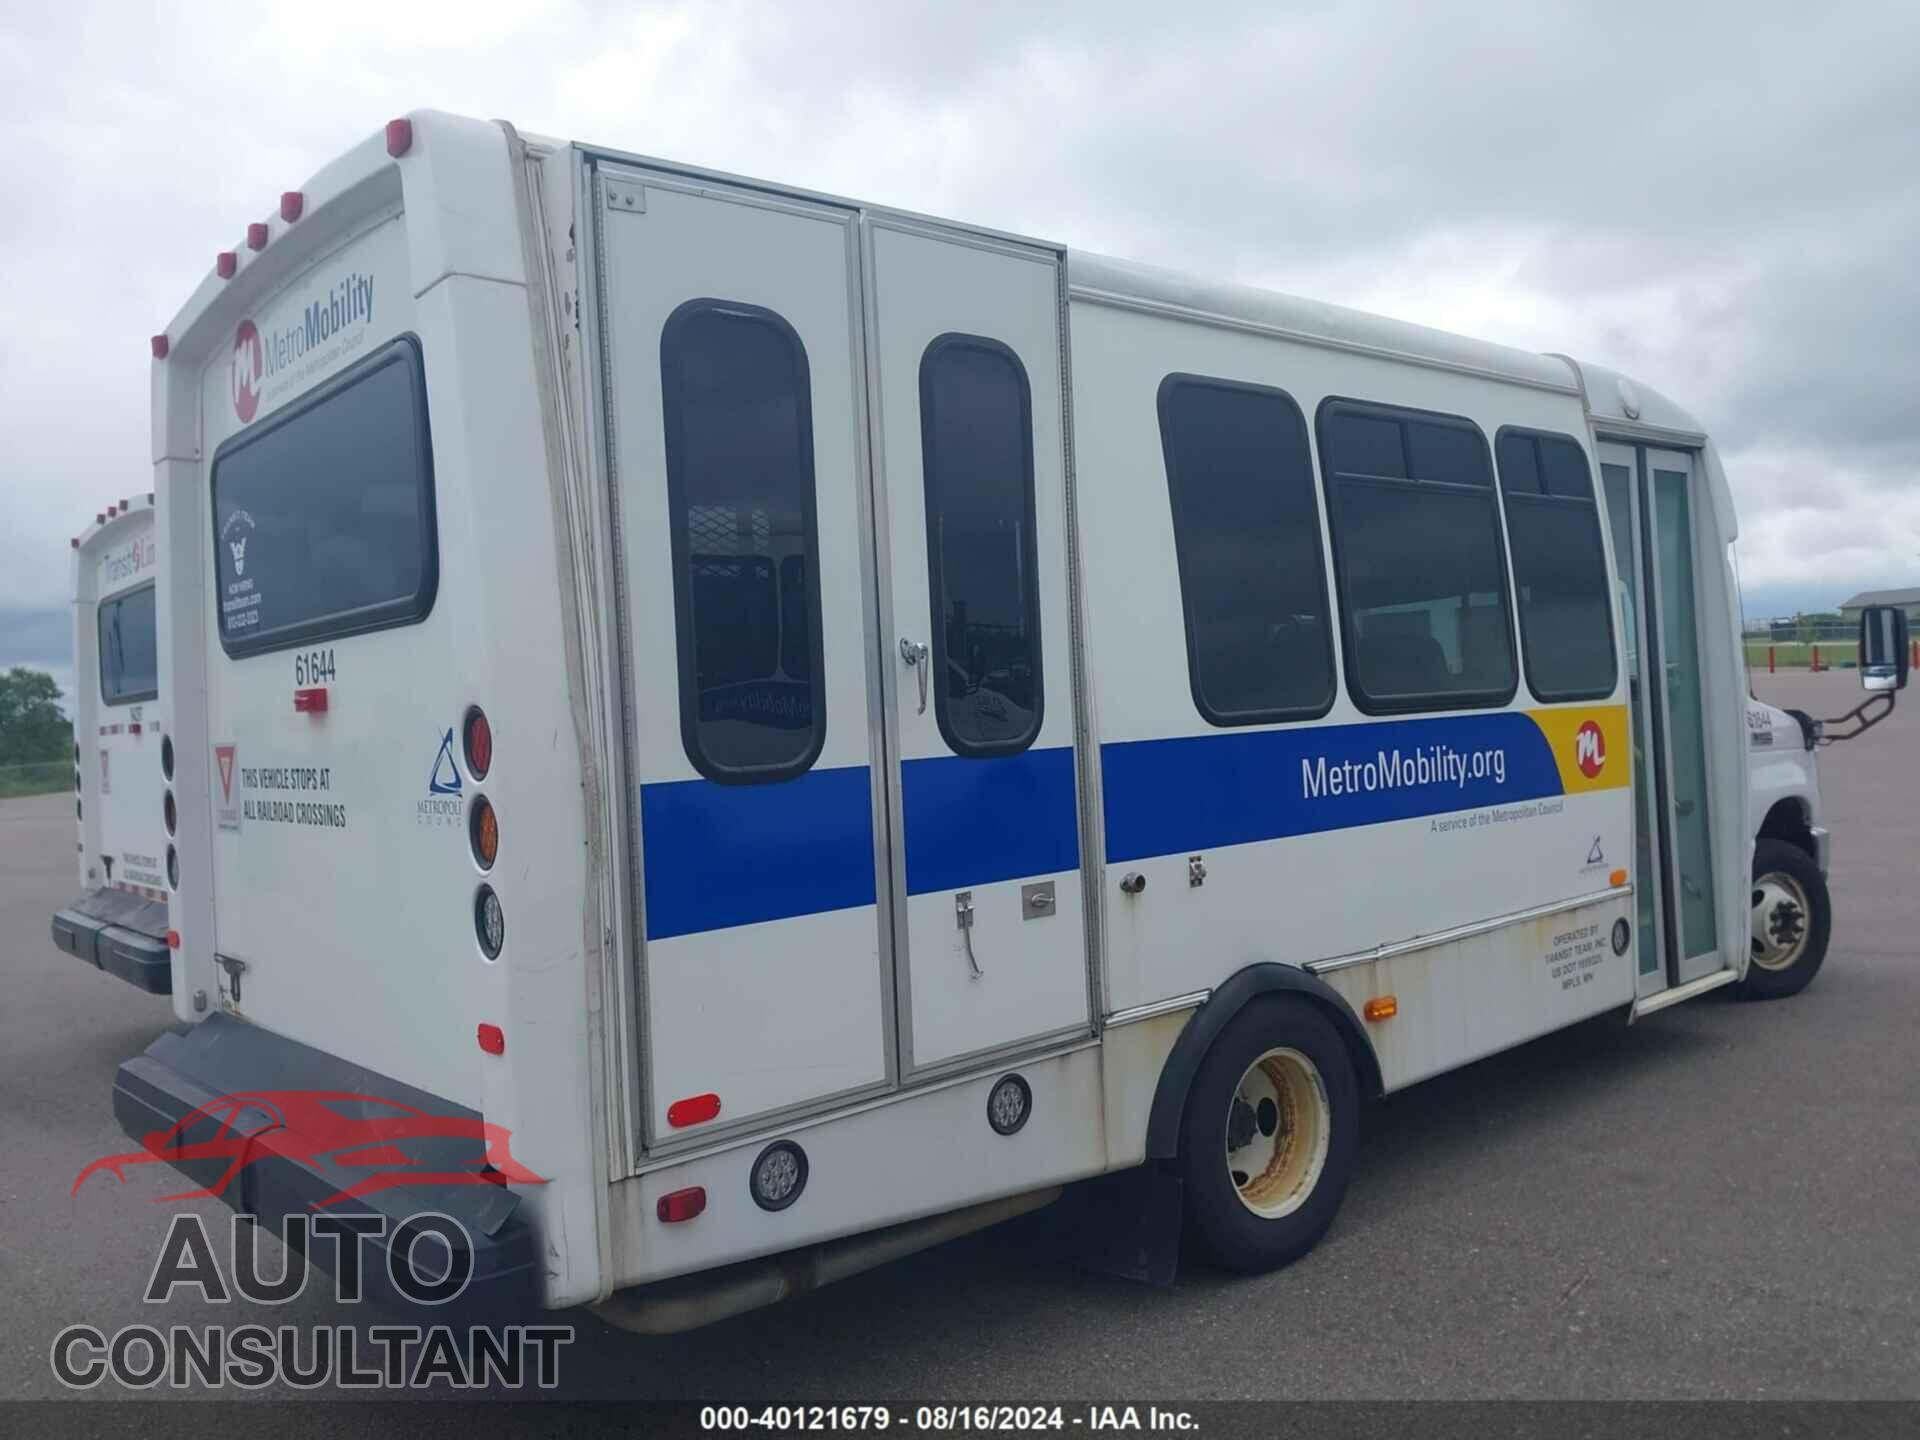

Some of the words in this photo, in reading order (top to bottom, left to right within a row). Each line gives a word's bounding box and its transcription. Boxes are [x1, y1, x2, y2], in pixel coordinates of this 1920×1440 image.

[265, 273, 374, 377] MetroMobility
[295, 649, 335, 686] 61644
[241, 768, 257, 789] THIS
[258, 768, 290, 790] VEHICLE
[291, 768, 318, 790] STOPS
[319, 768, 331, 790] AT
[1302, 745, 1506, 799] MetroMobility.org
[243, 800, 257, 820] ALL
[257, 801, 294, 824] RAILROAD
[295, 803, 346, 828] CROSSINGS
[417, 800, 463, 816] METROPOLI
[1430, 820, 1438, 832] A
[1439, 816, 1468, 832] service
[1469, 814, 1477, 828] of
[1478, 812, 1490, 826] the
[1491, 805, 1537, 824] Metropolitan
[1537, 800, 1564, 817] Council
